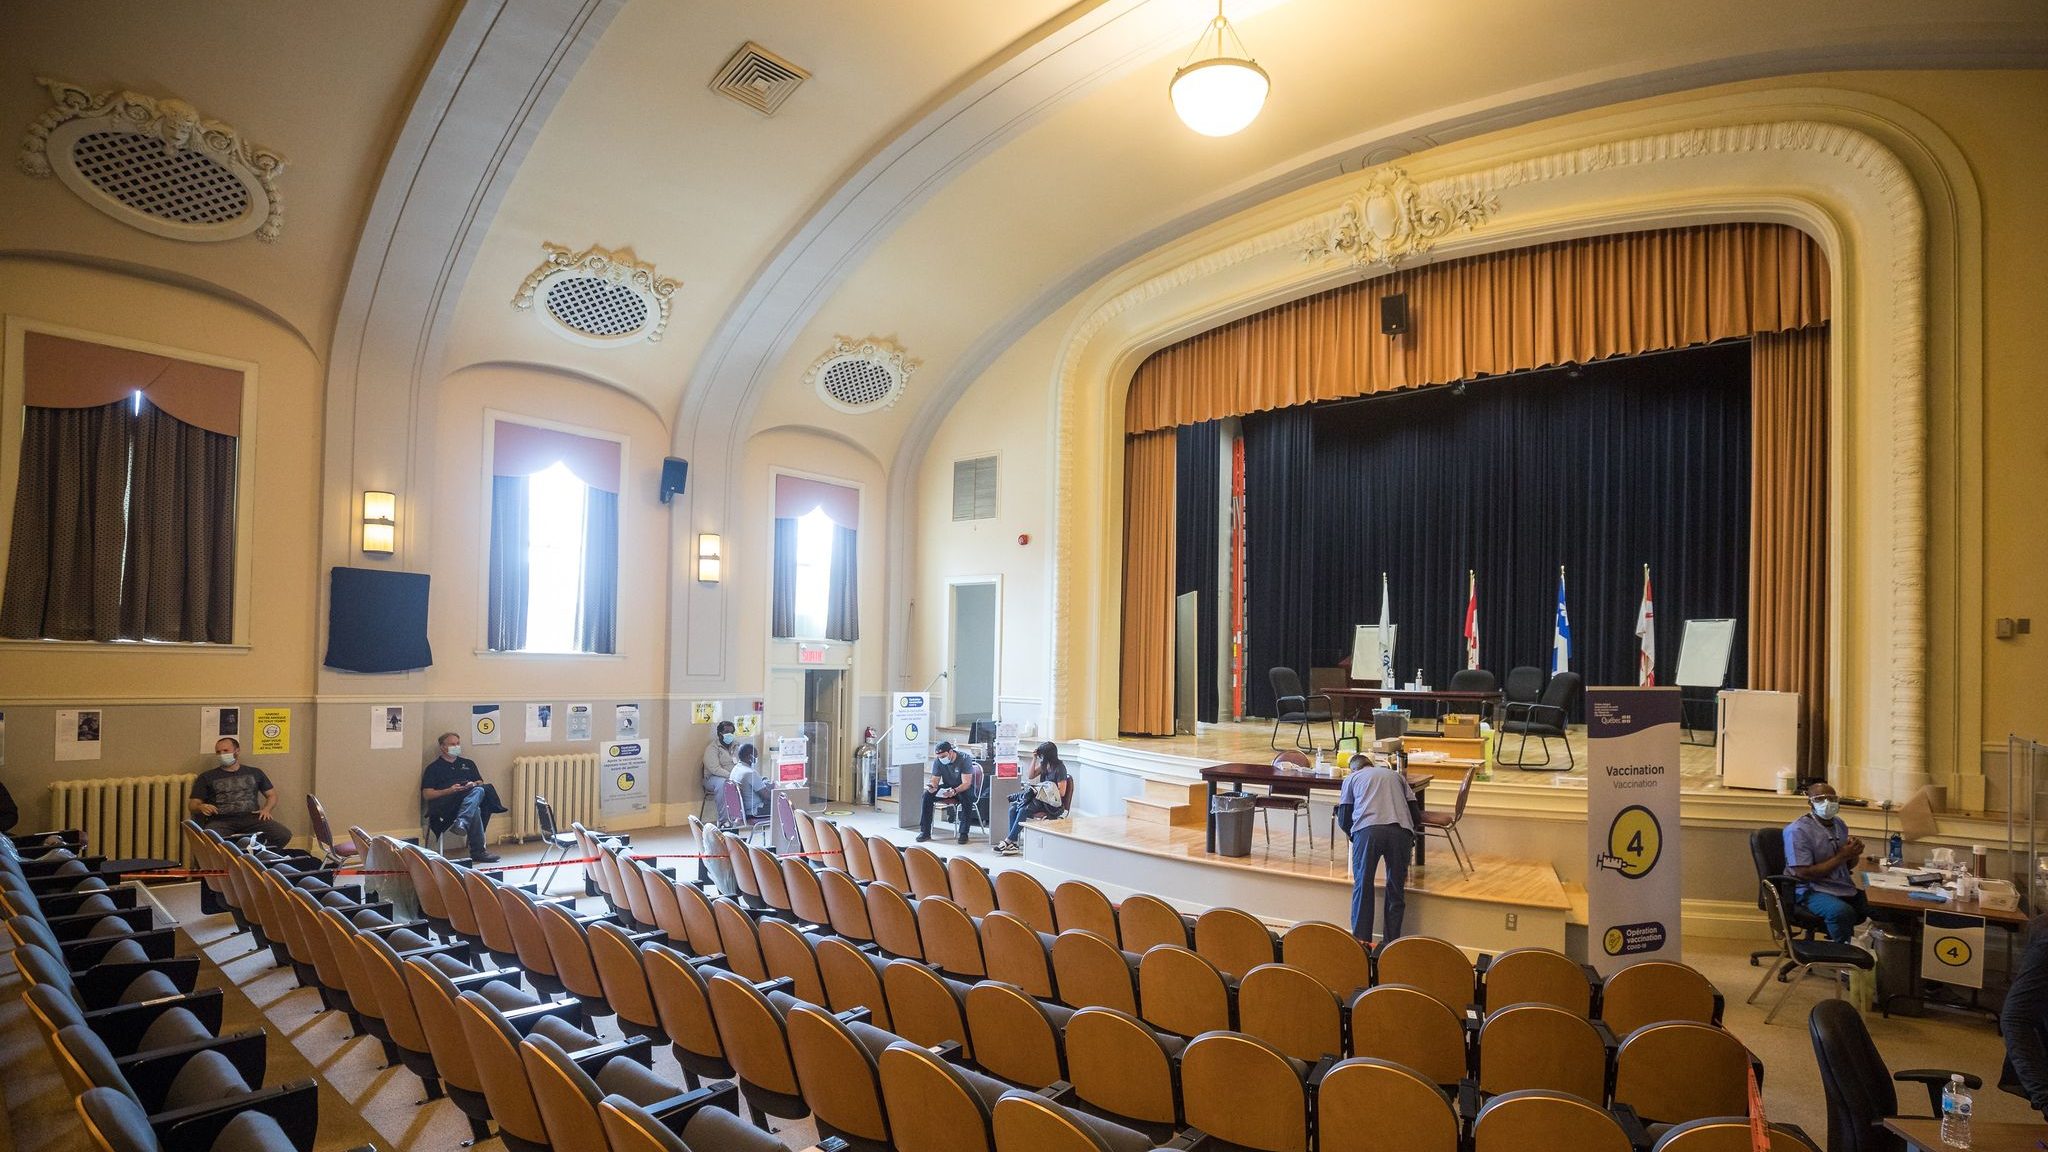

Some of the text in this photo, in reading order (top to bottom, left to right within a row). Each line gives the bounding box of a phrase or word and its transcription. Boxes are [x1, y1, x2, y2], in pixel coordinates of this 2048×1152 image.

[1601, 716, 1621, 724] Québec
[1606, 764, 1664, 776] Vaccination
[1613, 779, 1658, 789] Vaccination
[1627, 830, 1644, 857] 4
[1626, 926, 1658, 937] Opération
[1626, 934, 1662, 944] vaccination
[1947, 947, 1958, 958] 4
